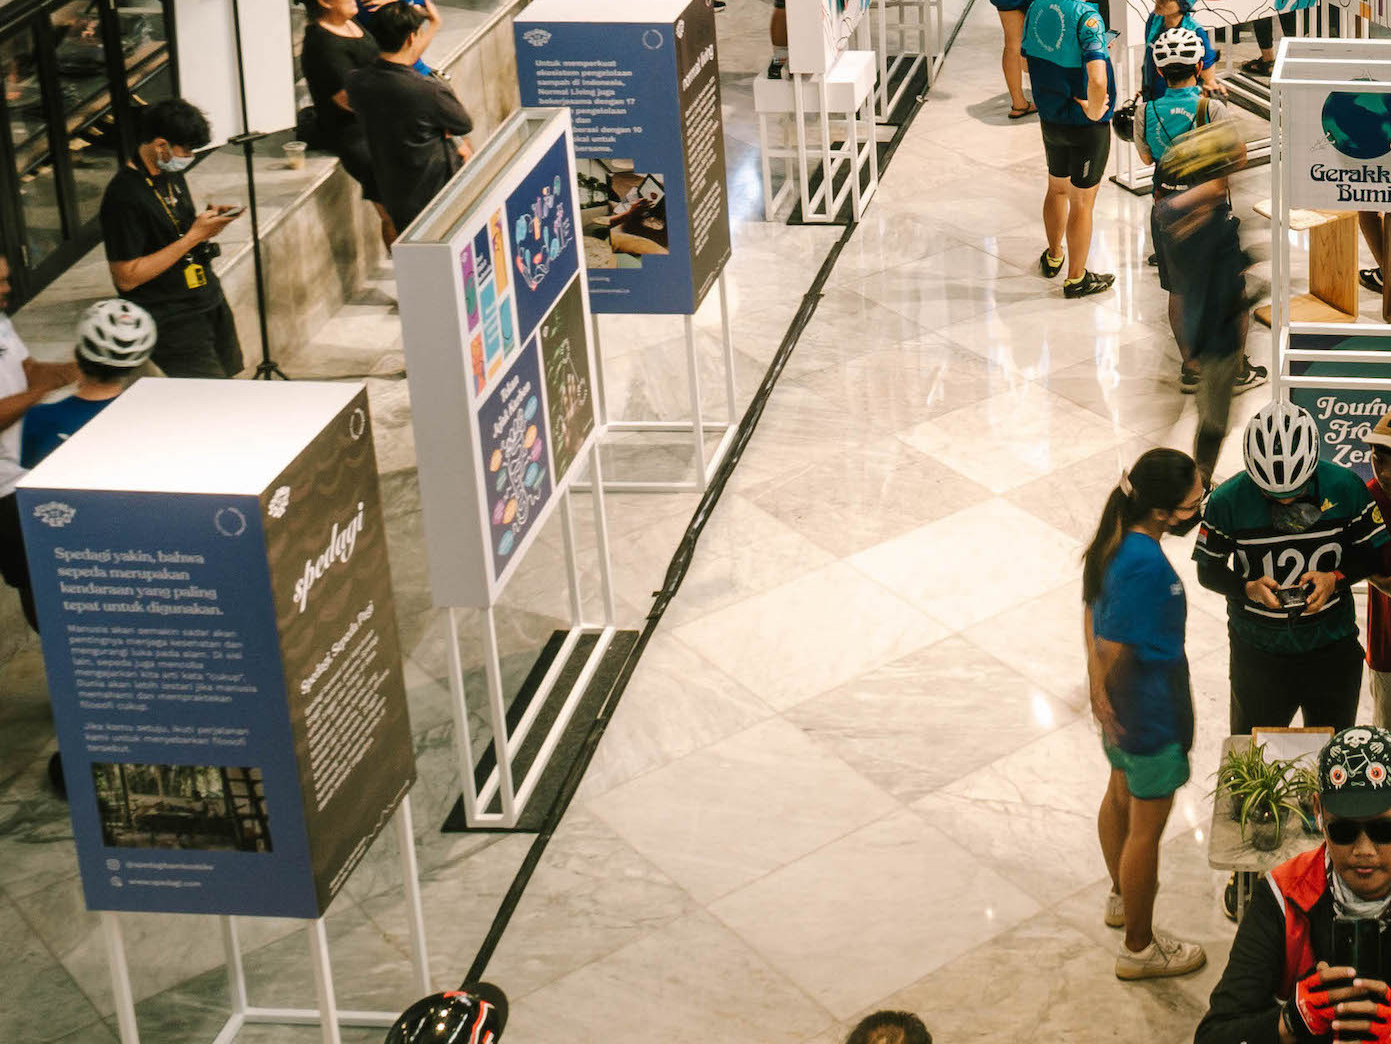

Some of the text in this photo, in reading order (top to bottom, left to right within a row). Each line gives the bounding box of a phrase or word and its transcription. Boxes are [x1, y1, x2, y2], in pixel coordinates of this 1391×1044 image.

[1324, 419, 1374, 444] Fro
[1332, 445, 1374, 468] Zer
[54, 547, 205, 564] Spedagi yakin, bahwa
[293, 502, 364, 614] spedagi
[57, 565, 190, 582] sepeda merupakan
[60, 581, 217, 600] kendaraan yang paling
[63, 600, 224, 616] tepat untuk digunakan.
